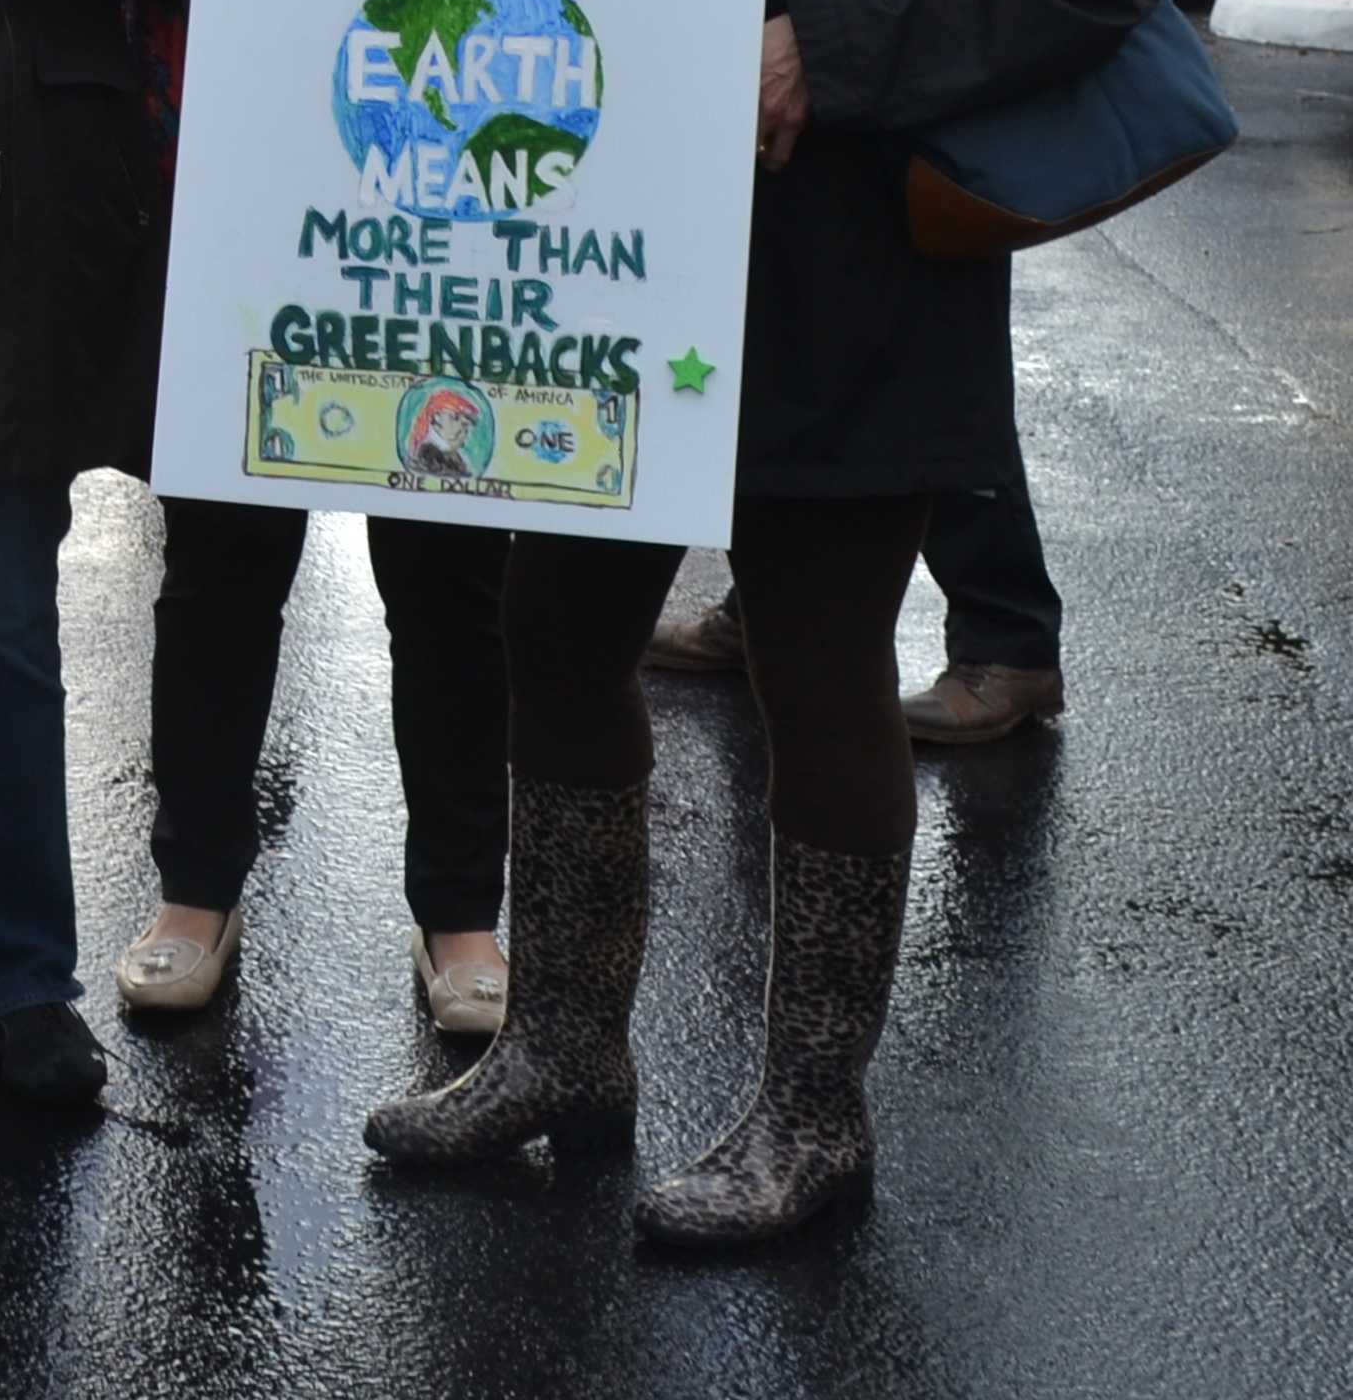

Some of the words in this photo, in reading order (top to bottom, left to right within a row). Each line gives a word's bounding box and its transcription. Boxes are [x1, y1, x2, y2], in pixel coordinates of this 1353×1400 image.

[346, 30, 599, 109] EARTH
[356, 141, 576, 211] MEANS
[297, 205, 453, 267] MORE
[492, 220, 648, 282] THAN
[341, 266, 559, 329] THEIR
[270, 304, 642, 395] GREENBACKS
[488, 386, 508, 400] OF
[515, 428, 575, 453] ONE
[387, 471, 427, 491] ONE
[440, 477, 516, 500] DOLLAR
